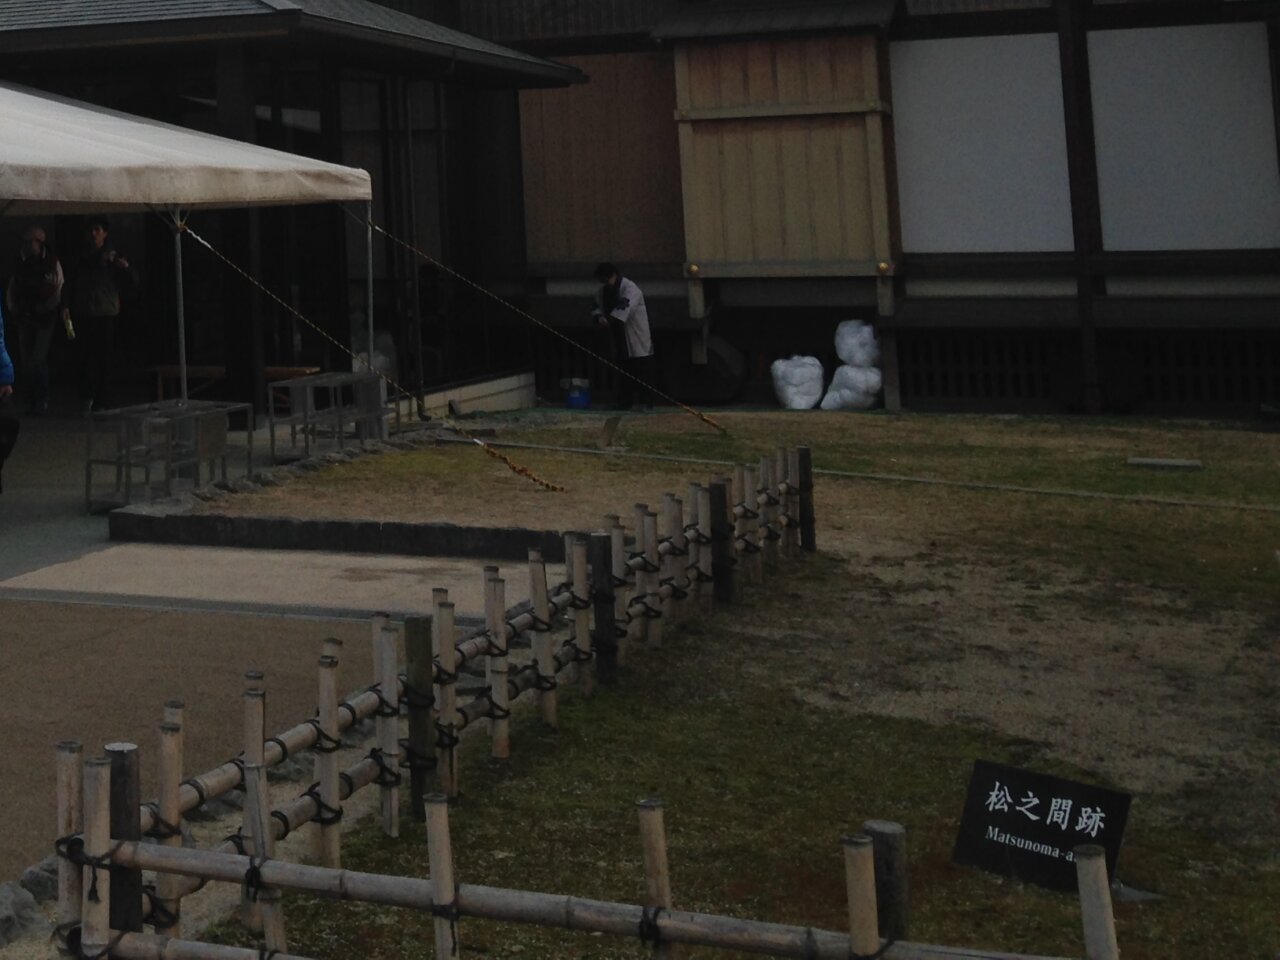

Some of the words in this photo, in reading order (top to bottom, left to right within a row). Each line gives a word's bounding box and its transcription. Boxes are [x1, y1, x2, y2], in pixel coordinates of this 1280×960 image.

[985, 781, 1106, 838] 松之間跡
[985, 825, 1077, 863] Matsunoma-a
